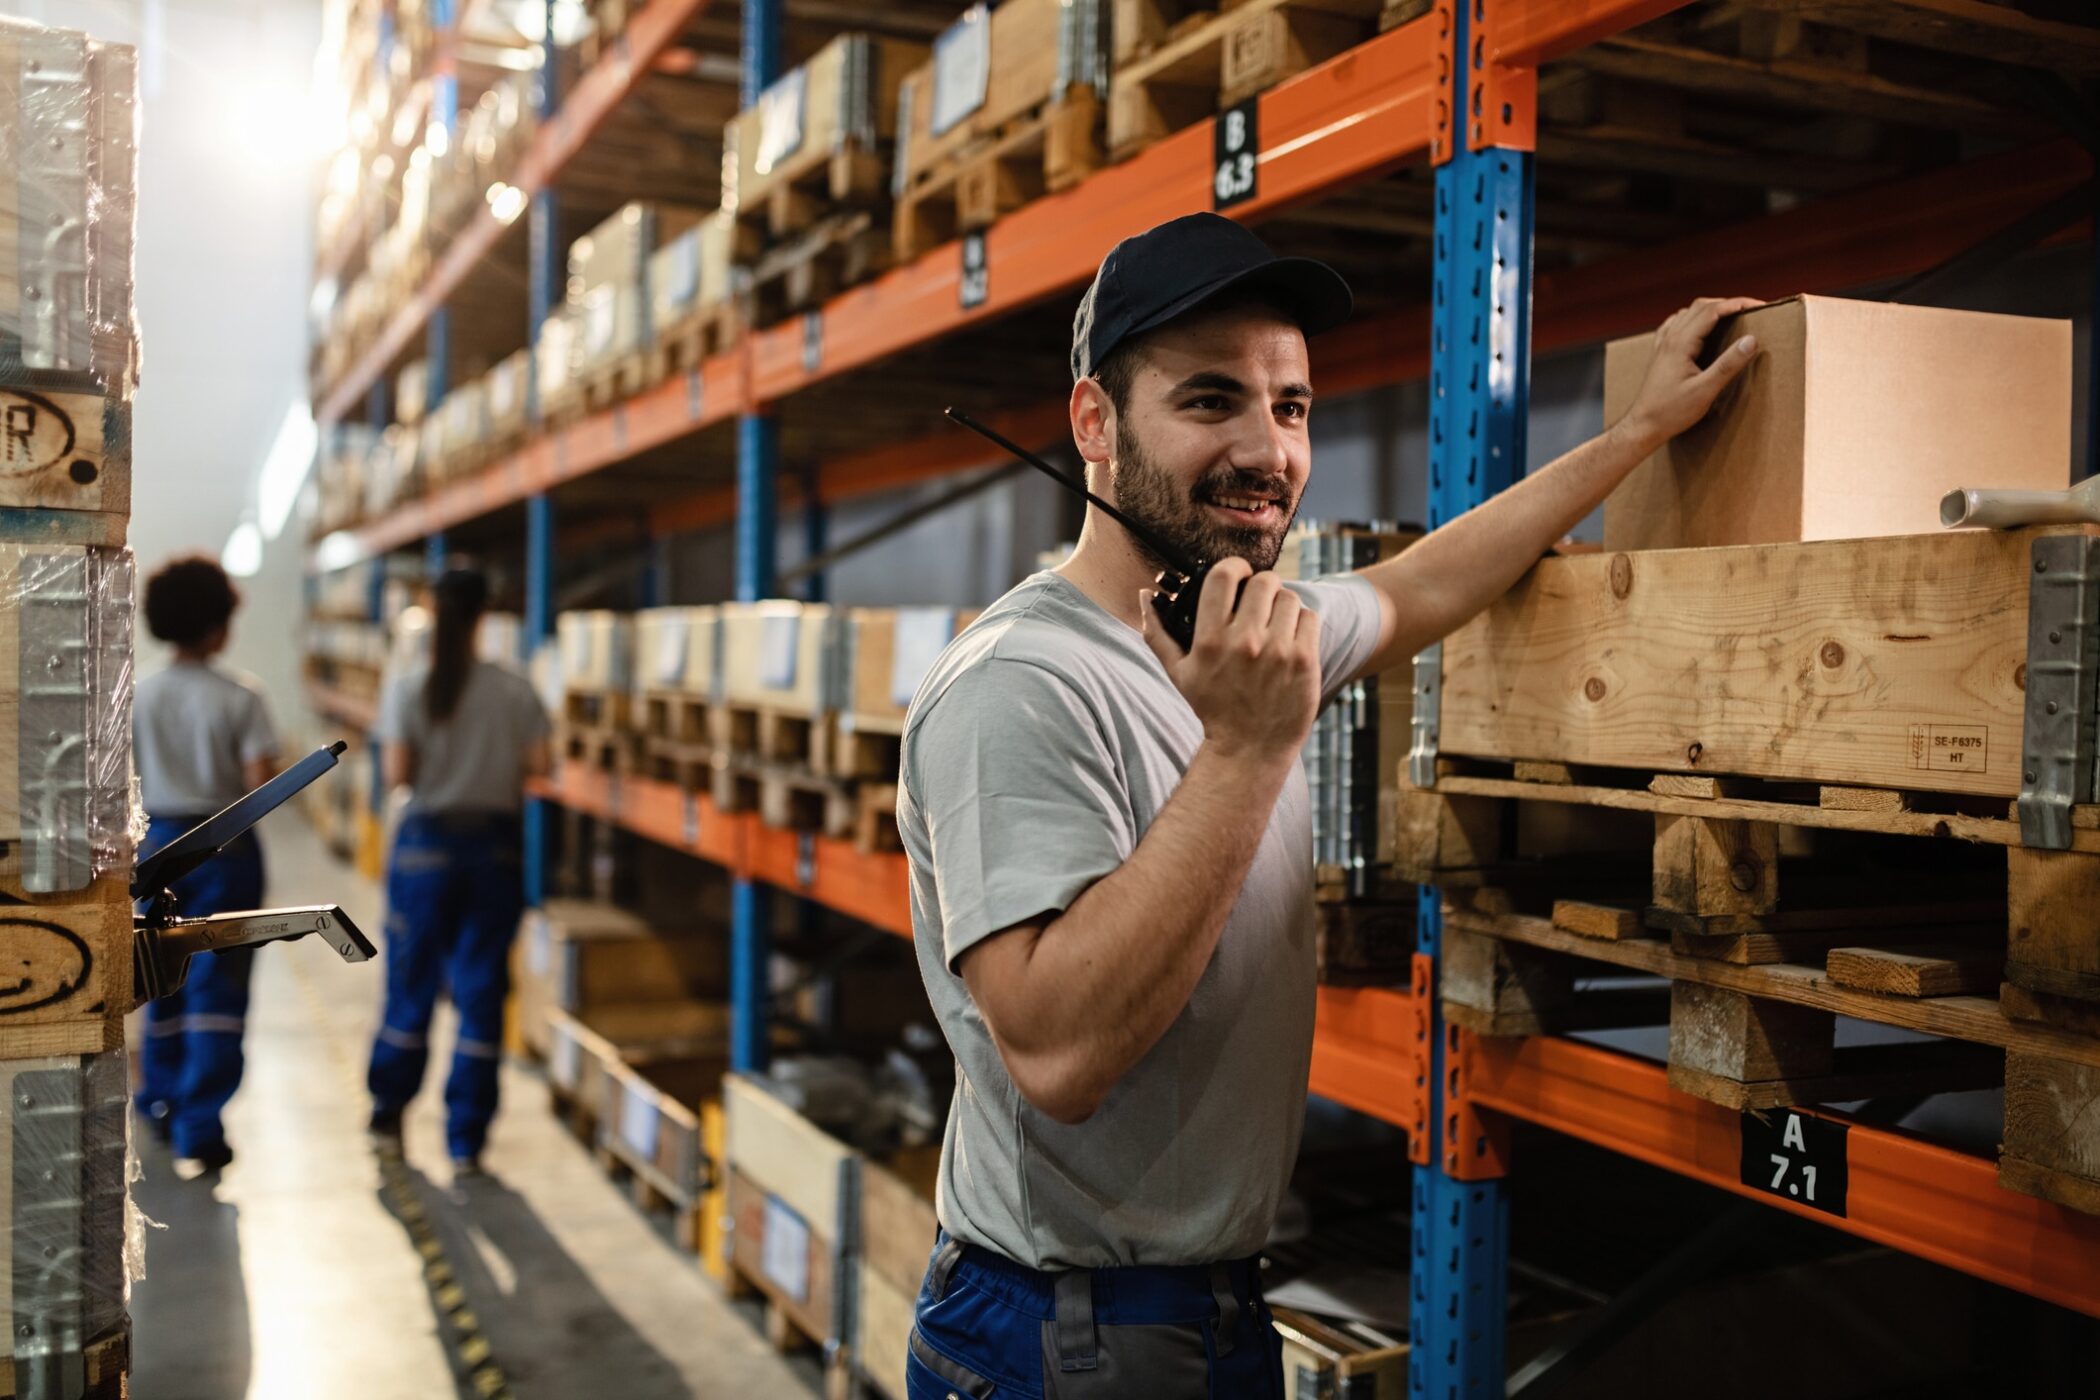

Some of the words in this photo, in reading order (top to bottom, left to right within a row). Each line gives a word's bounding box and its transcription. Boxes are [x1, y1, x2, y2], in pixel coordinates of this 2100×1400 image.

[1225, 110, 1245, 152] B
[1215, 152, 1254, 199] 6.3
[0, 405, 36, 462] R
[1935, 736, 1982, 748] SE-F6375
[1950, 752, 1964, 763] HT
[1783, 1113, 1806, 1153] A
[1770, 1153, 1817, 1201] 7.1
